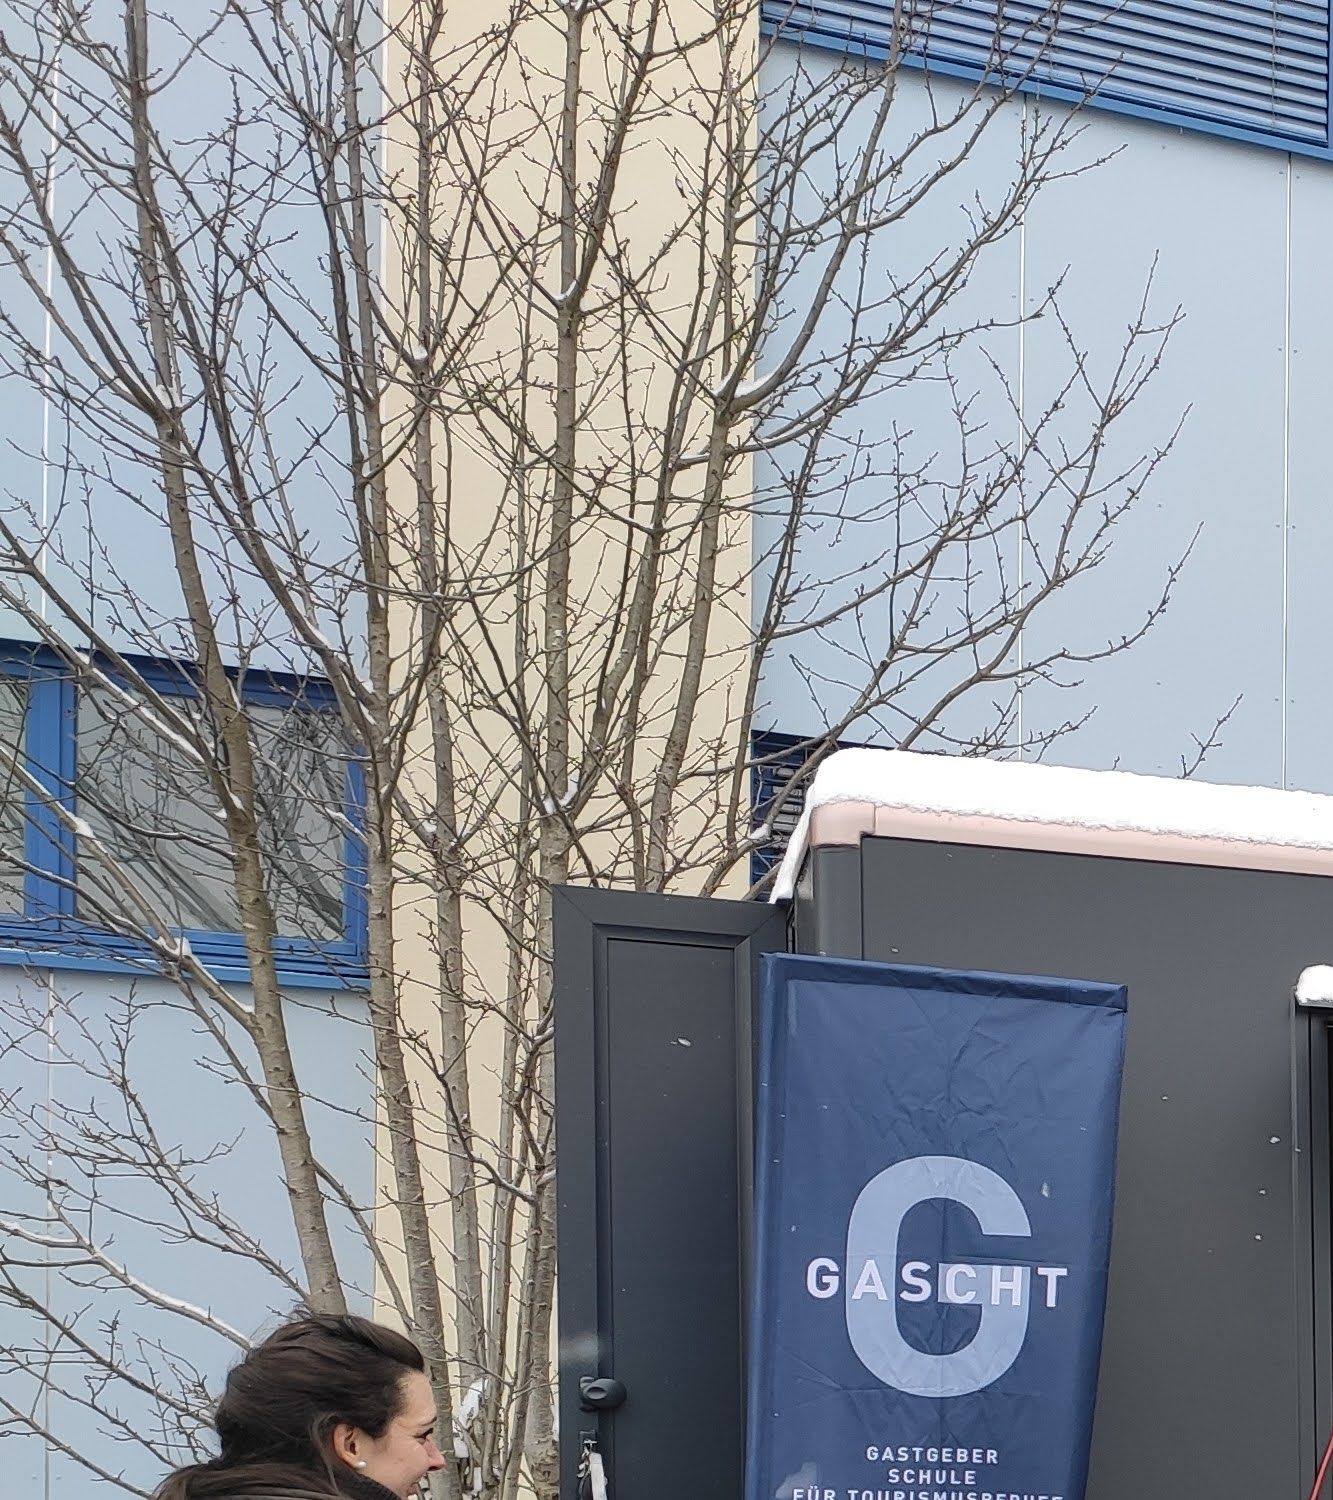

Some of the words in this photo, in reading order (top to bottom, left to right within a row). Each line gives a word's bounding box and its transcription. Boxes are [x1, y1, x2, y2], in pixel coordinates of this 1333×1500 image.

[806, 1256, 1068, 1309] GASCHT
[866, 1446, 999, 1464] GASTGEBER
[888, 1468, 977, 1485] SCHULE
